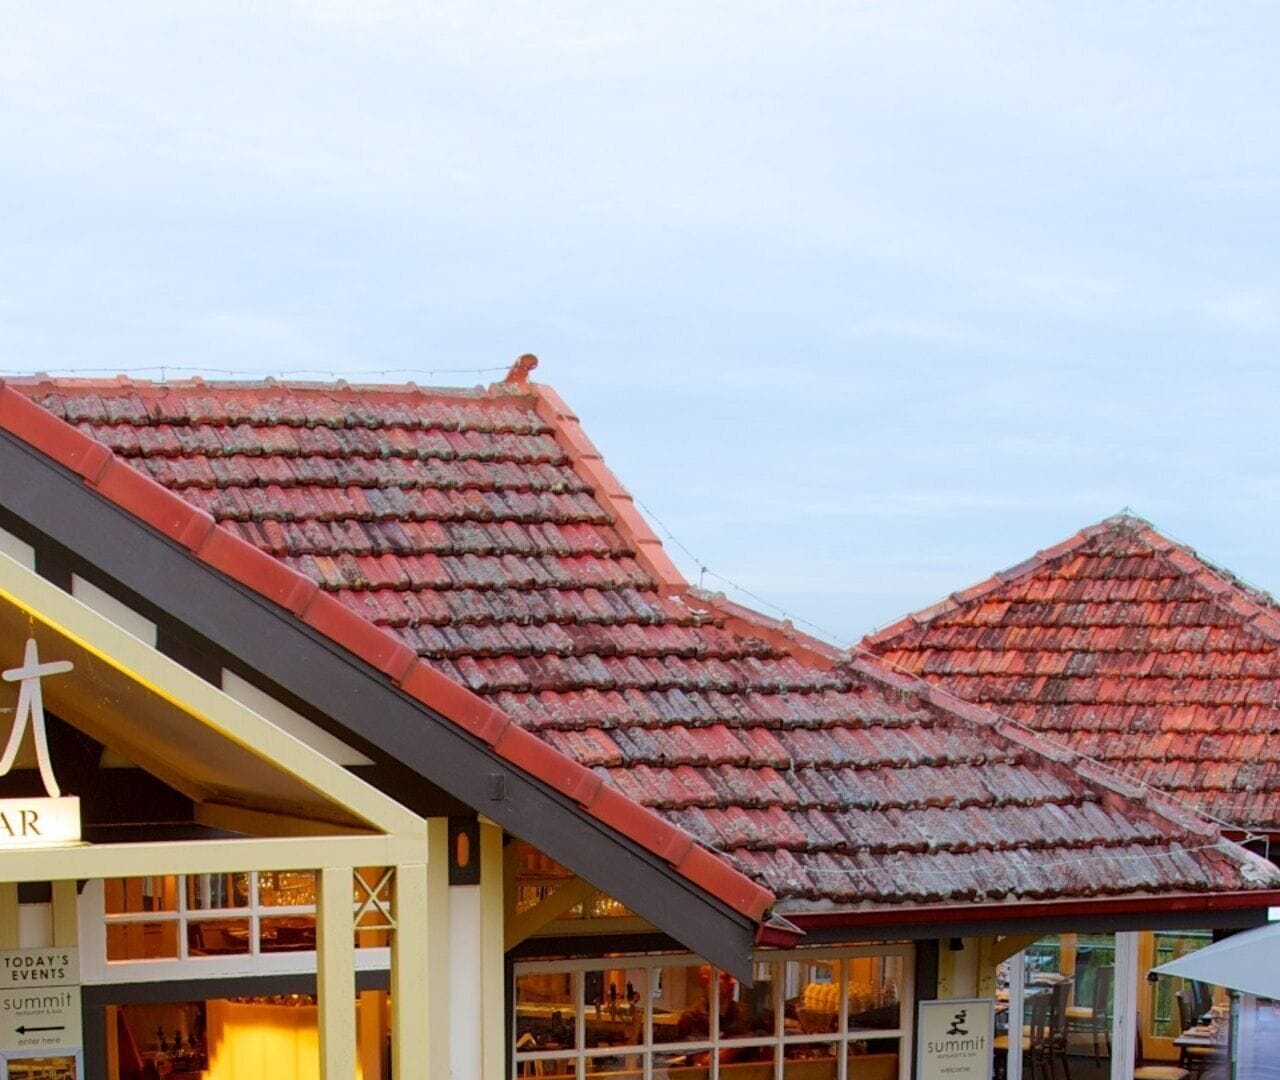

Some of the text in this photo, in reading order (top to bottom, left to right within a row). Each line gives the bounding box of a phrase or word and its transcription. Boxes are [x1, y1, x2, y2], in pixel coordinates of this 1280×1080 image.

[4, 955, 69, 968] TODAY'S
[12, 968, 65, 980] EVENTS
[3, 992, 72, 1010] summit
[18, 1037, 61, 1046] enter here
[927, 1036, 984, 1053] summit
